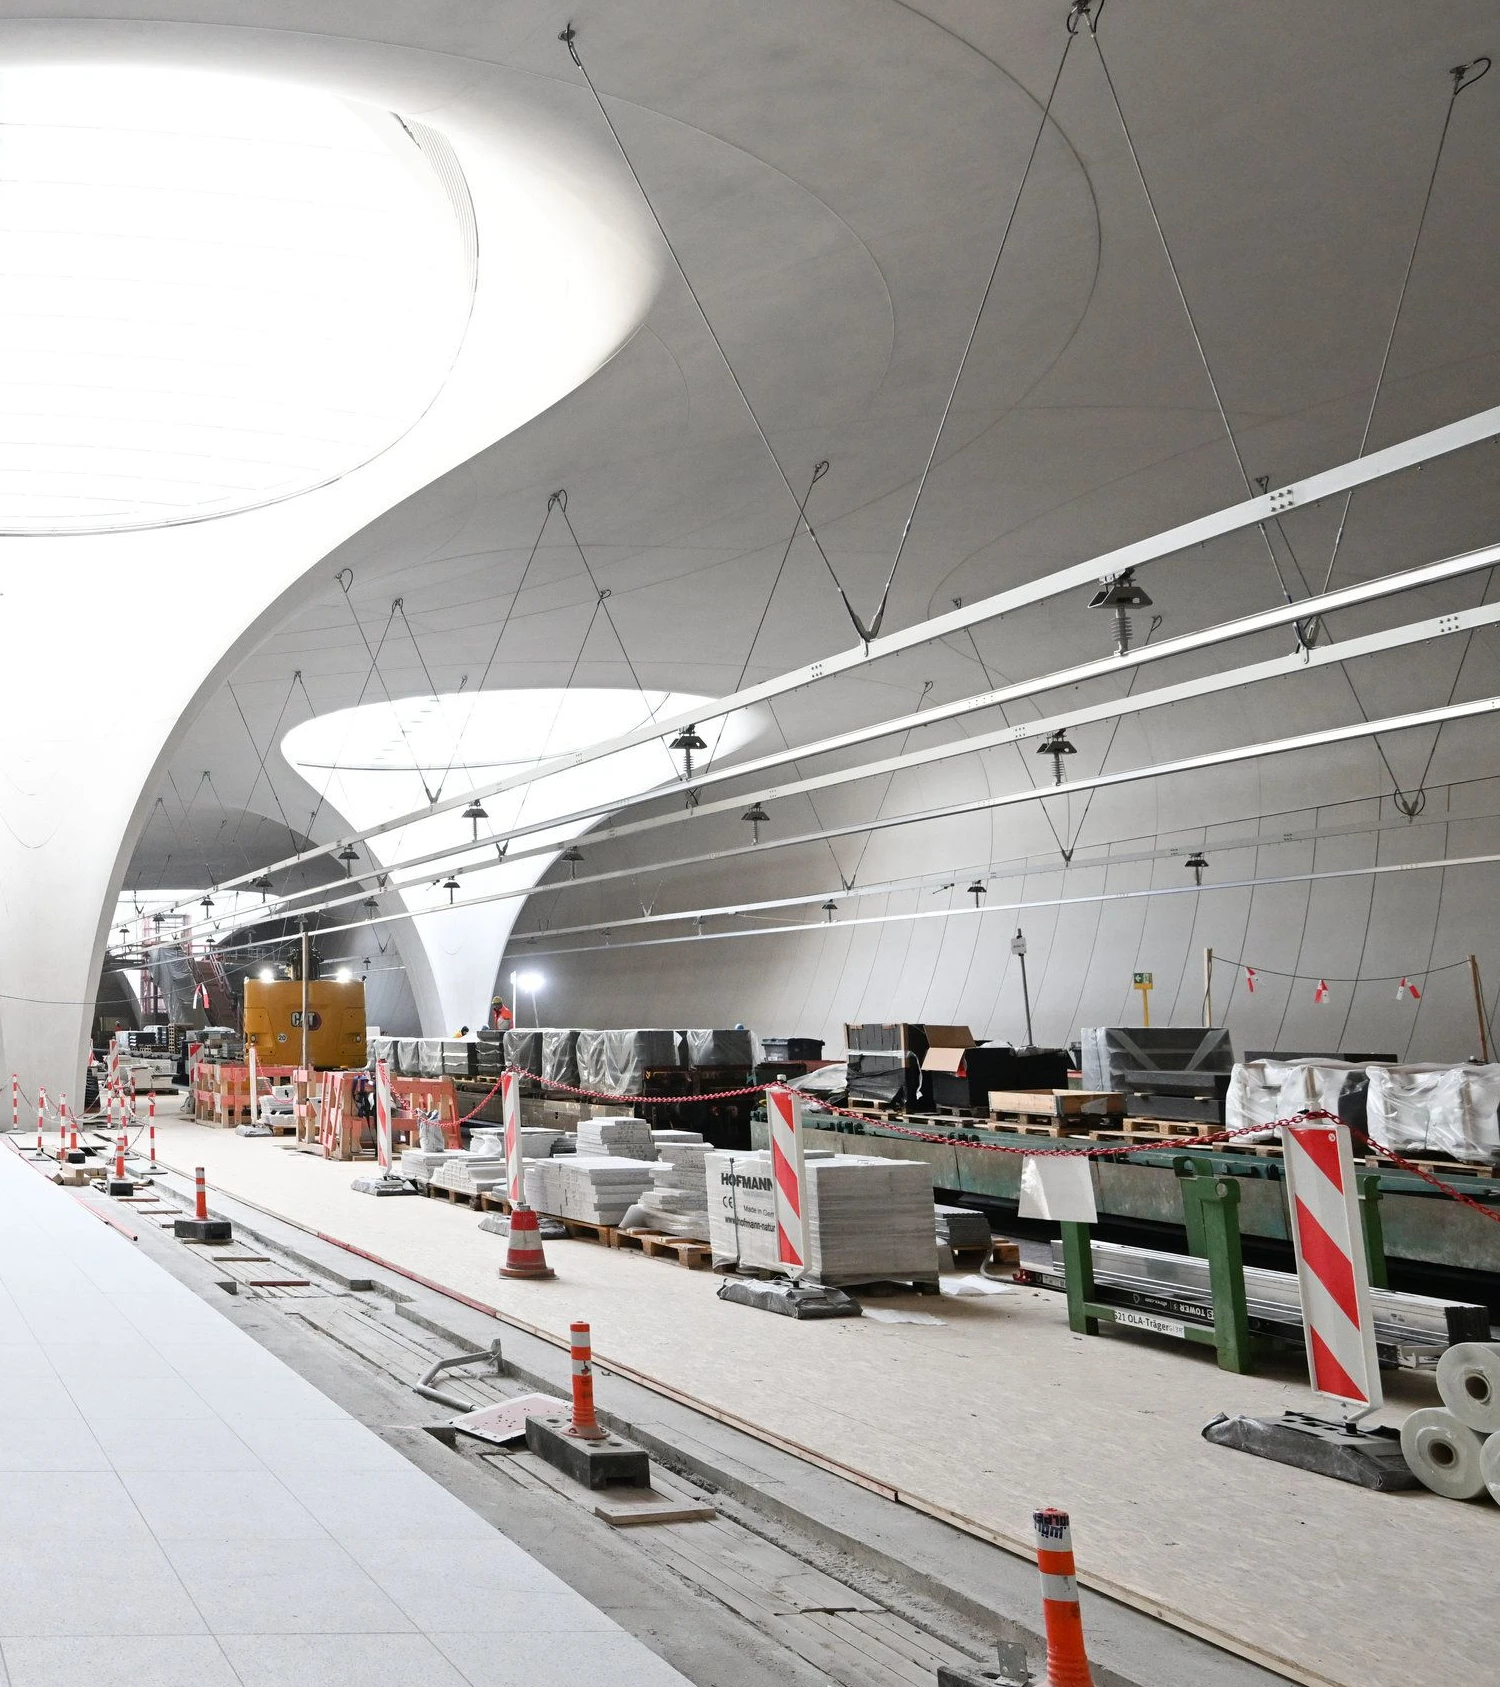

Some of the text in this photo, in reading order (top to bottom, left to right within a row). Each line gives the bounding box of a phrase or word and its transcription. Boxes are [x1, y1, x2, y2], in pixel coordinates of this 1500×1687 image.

[721, 1173, 773, 1191] HOFMANN
[743, 1205, 756, 1214] Made
[725, 1216, 775, 1232] wwwhofmann-natur
[1180, 1304, 1206, 1317] TOWER
[1128, 1314, 1168, 1332] OLA-Träger
